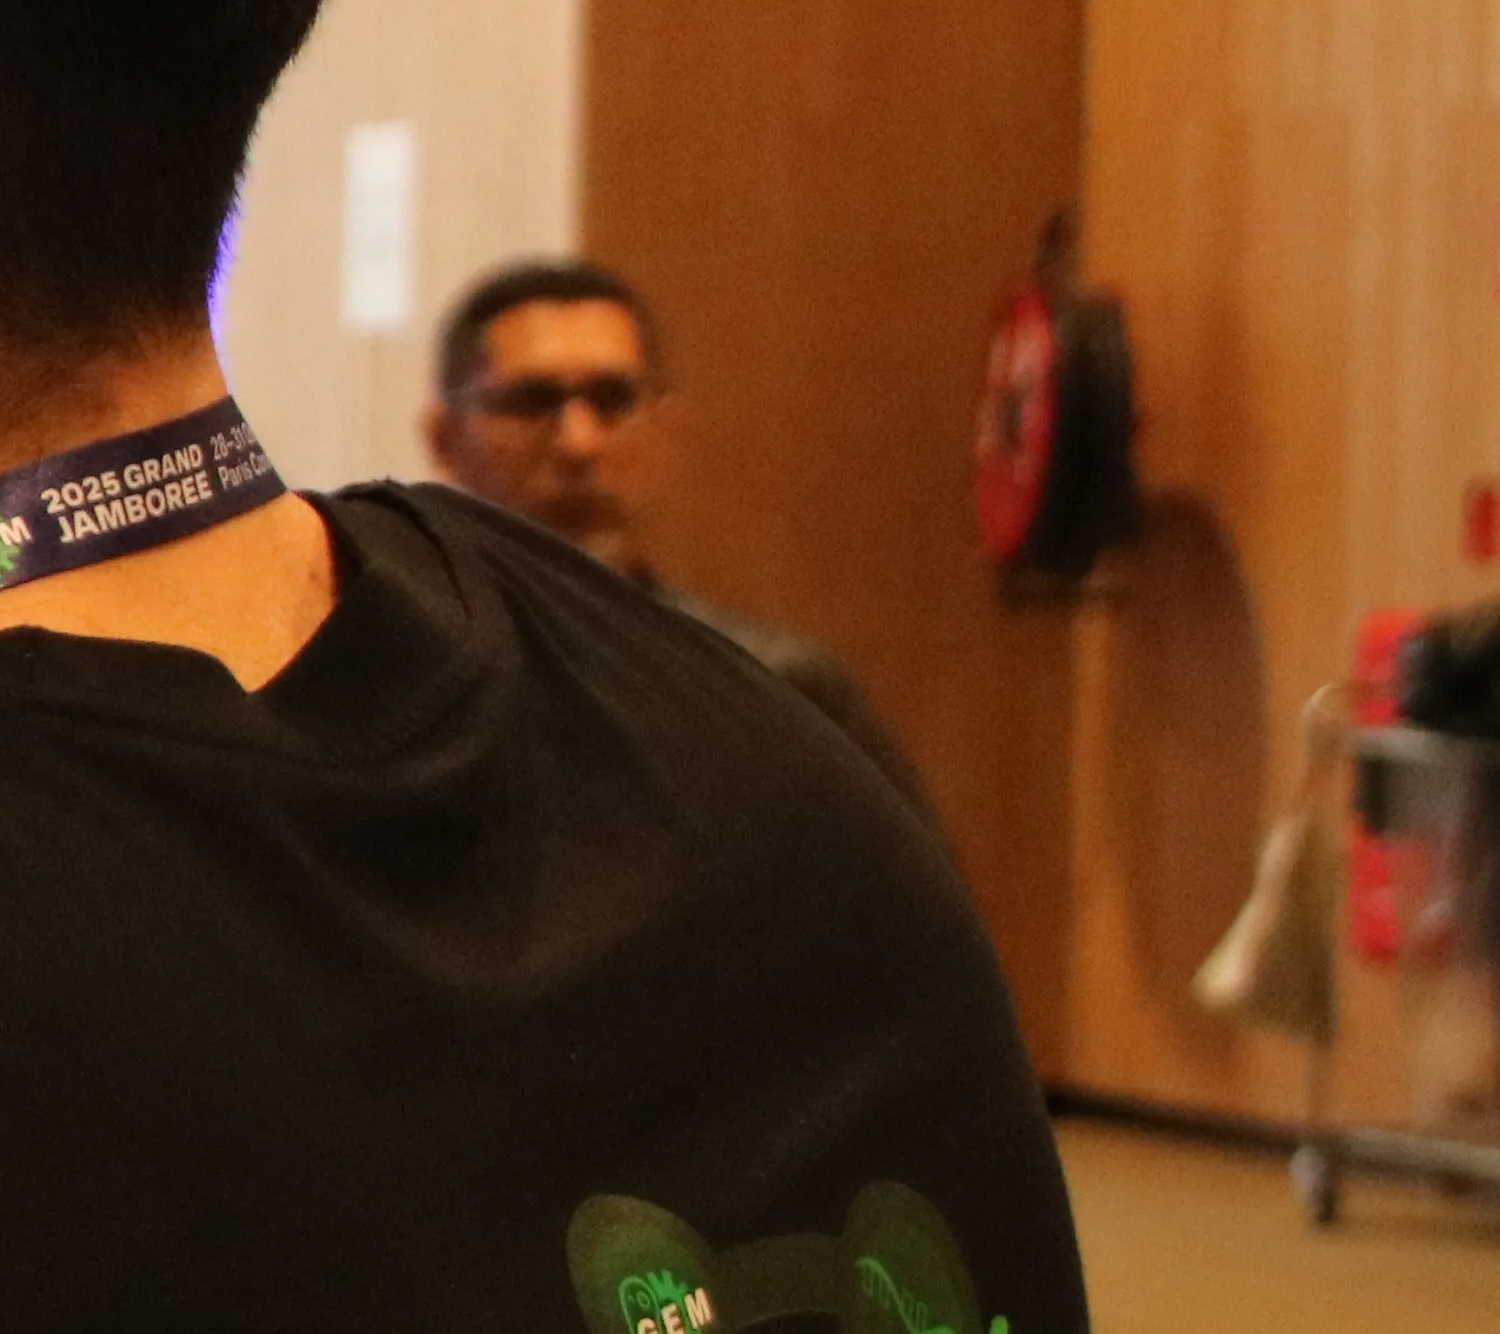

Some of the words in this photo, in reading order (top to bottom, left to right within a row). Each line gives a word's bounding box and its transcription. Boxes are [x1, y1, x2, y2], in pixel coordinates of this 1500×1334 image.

[41, 470, 121, 515] 2025
[123, 443, 203, 490] GRAND
[58, 469, 214, 543] JAMBOREE
